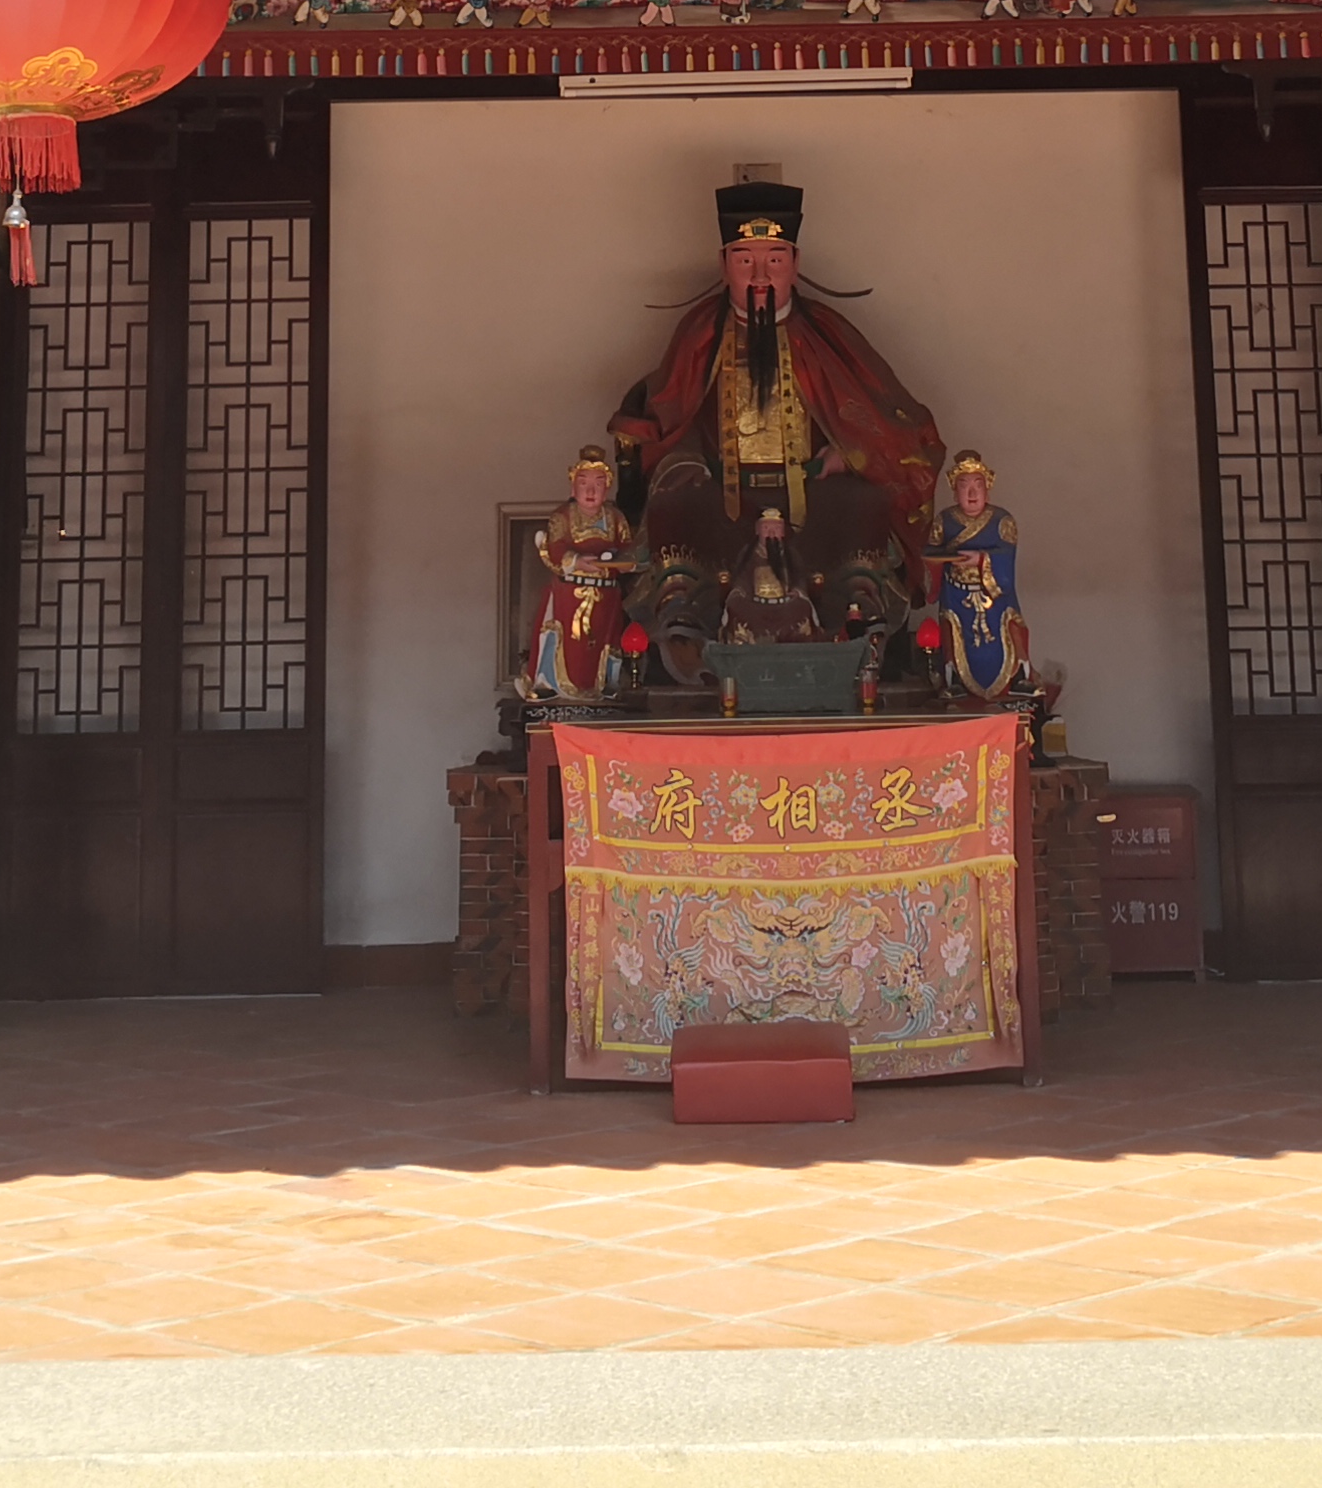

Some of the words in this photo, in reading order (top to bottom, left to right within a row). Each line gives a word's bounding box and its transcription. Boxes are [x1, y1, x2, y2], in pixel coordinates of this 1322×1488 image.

[649, 765, 935, 841] 丞相府
[1111, 827, 1171, 845] 灭火器箱
[1111, 900, 1179, 924] 火警119
